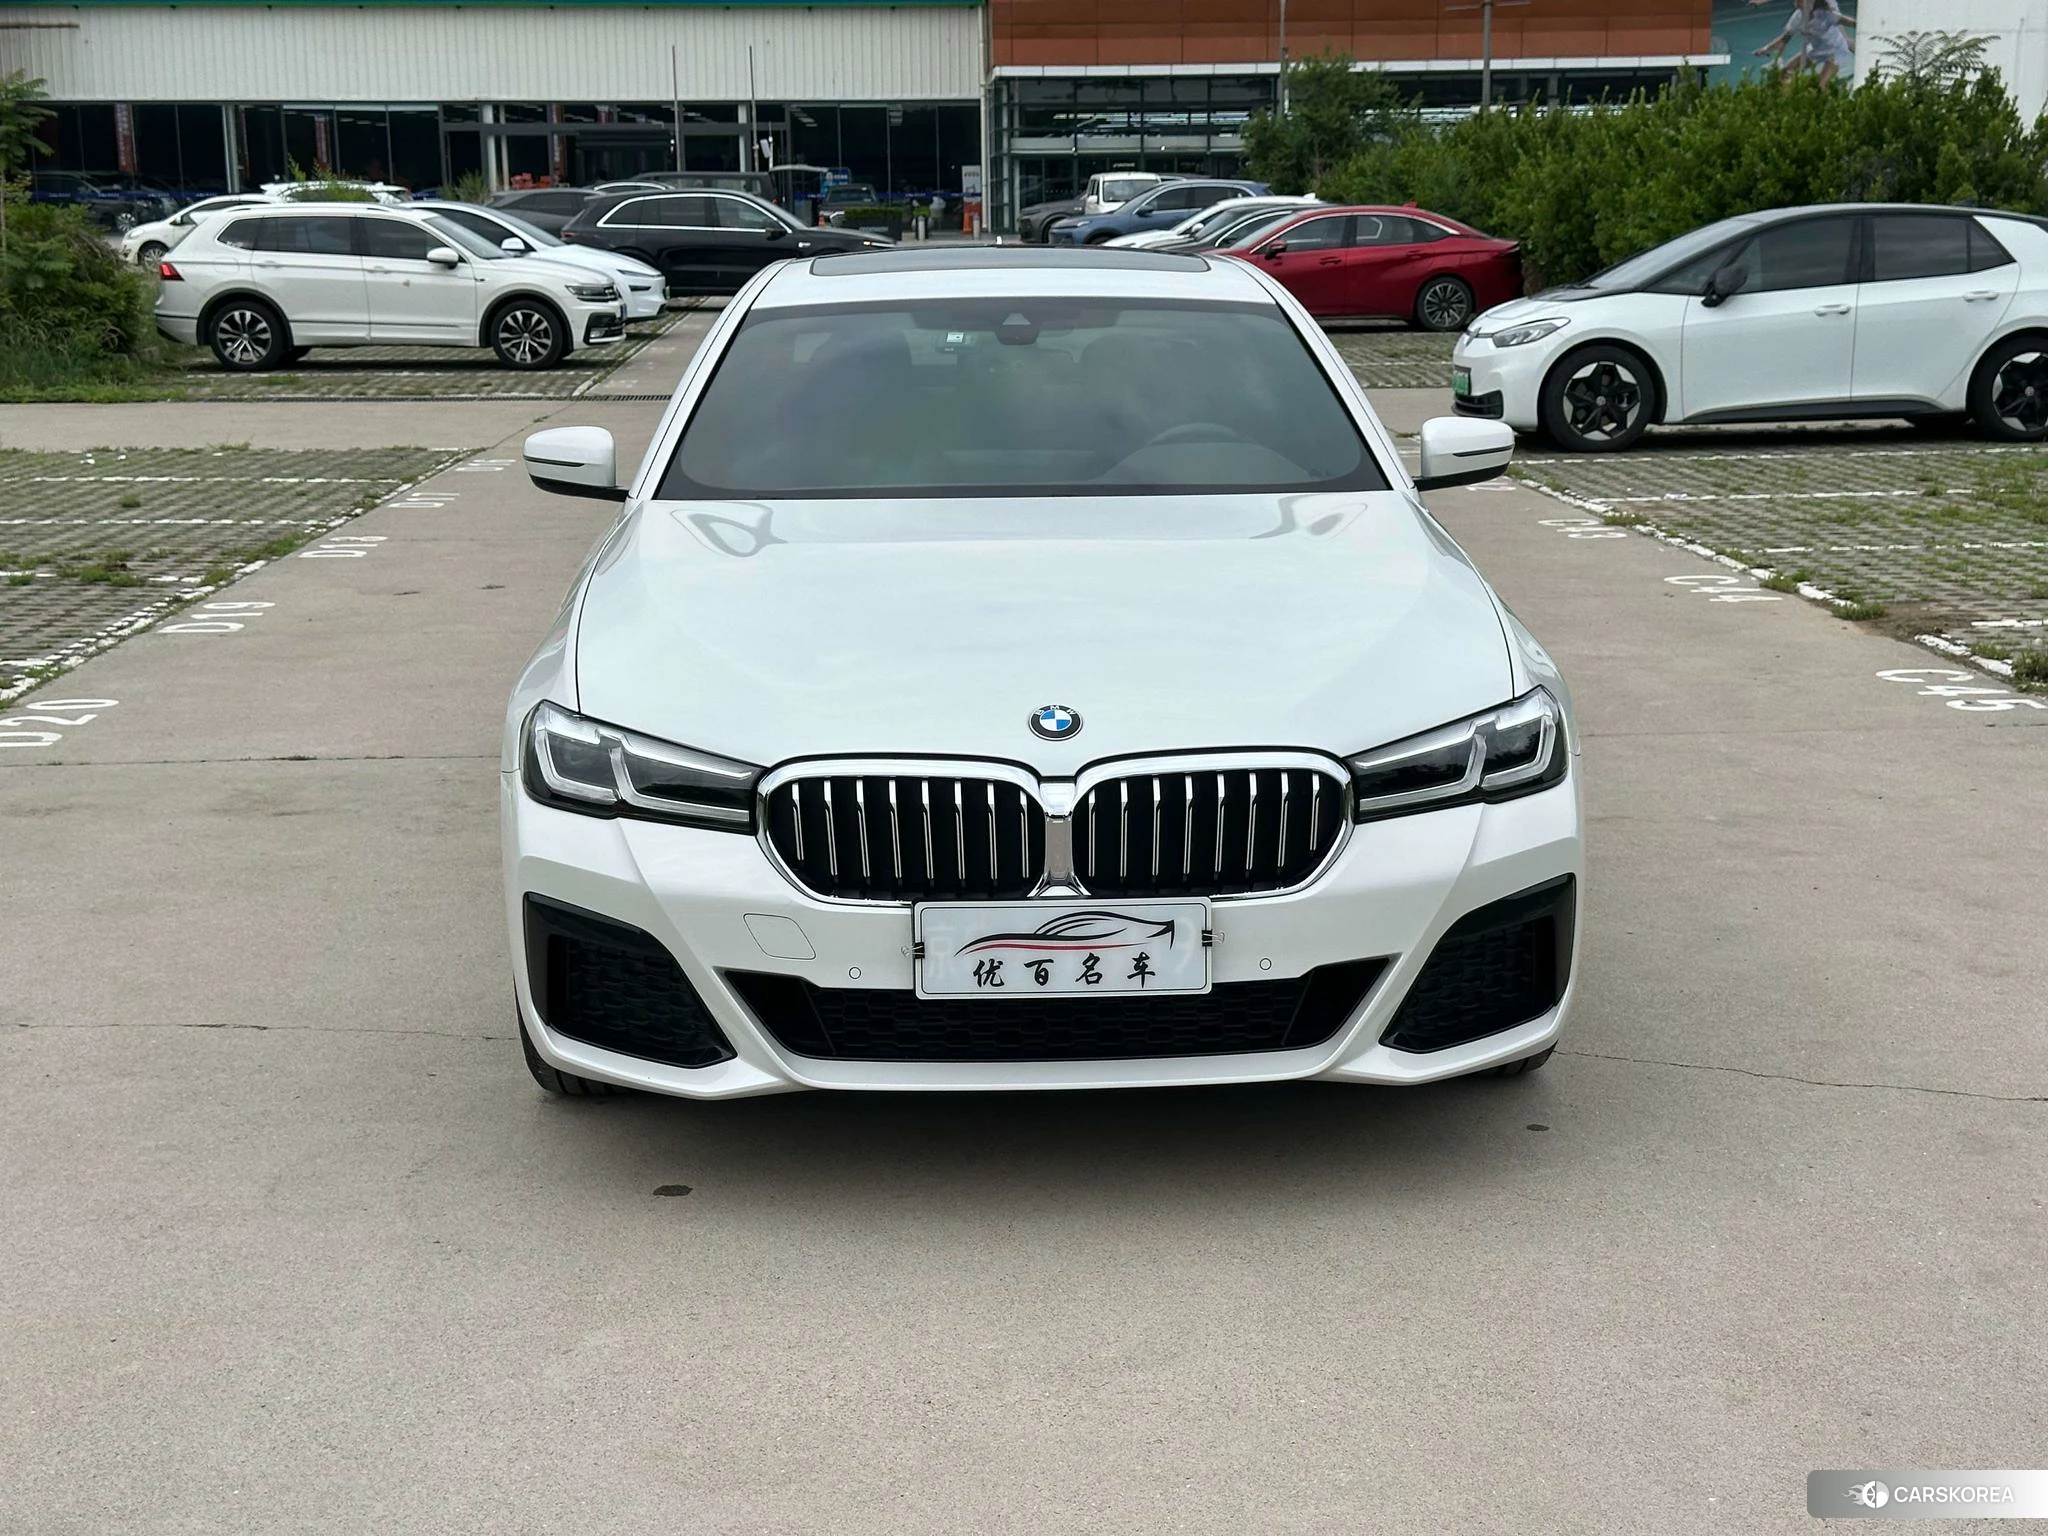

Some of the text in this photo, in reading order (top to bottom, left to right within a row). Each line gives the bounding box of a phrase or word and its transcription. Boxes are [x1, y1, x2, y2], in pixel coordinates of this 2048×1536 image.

[298, 535, 388, 558] D18
[1664, 575, 1783, 603] C44
[156, 601, 276, 634] D19
[1875, 668, 2048, 711] C45
[0, 698, 120, 748] D20
[972, 951, 1156, 989] 优百名车
